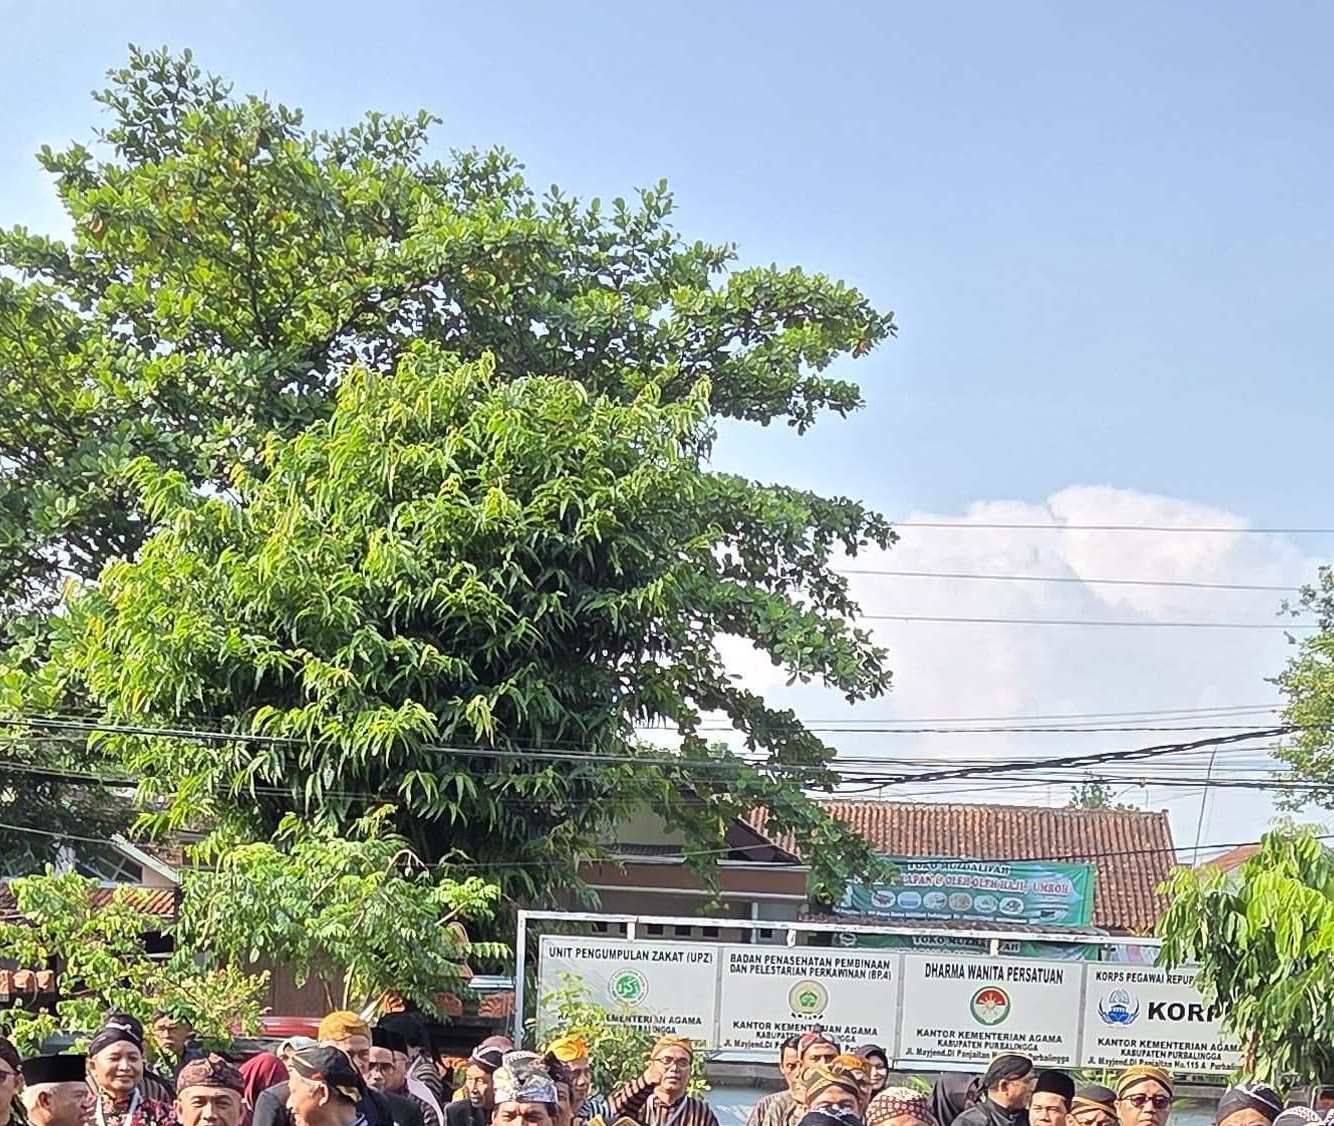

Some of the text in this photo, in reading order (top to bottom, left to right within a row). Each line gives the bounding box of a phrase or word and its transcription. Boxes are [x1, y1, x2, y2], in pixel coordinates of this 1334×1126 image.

[549, 947, 713, 964] UNIT PENGUMPULAN ZAKAT (UPZ)
[730, 953, 890, 970] BADAN PENASEHATAN PEMBINAAN
[730, 964, 747, 974] DAN
[749, 965, 807, 976] PELESTARIAN
[809, 966, 866, 979] PERKAWINAN
[925, 963, 1064, 984] DHARMA WANITA PERSATUAN
[1096, 971, 1124, 983] KORPS
[1126, 972, 1164, 984] PEGAWAI
[669, 1015, 702, 1025] AGAMA
[733, 1020, 772, 1030] KANTOR
[844, 1025, 878, 1036] AGAMA
[916, 1028, 1063, 1043] KANTOR KEMENTERIAN AGAMA
[937, 1039, 1038, 1051] KABUPATEN PURBALINGGA
[1098, 1038, 1137, 1048] KANTOR
[1139, 1040, 1208, 1051] KEMENTERIAN
[1121, 1049, 1222, 1061] KABUPATEN PURBALINGGA
